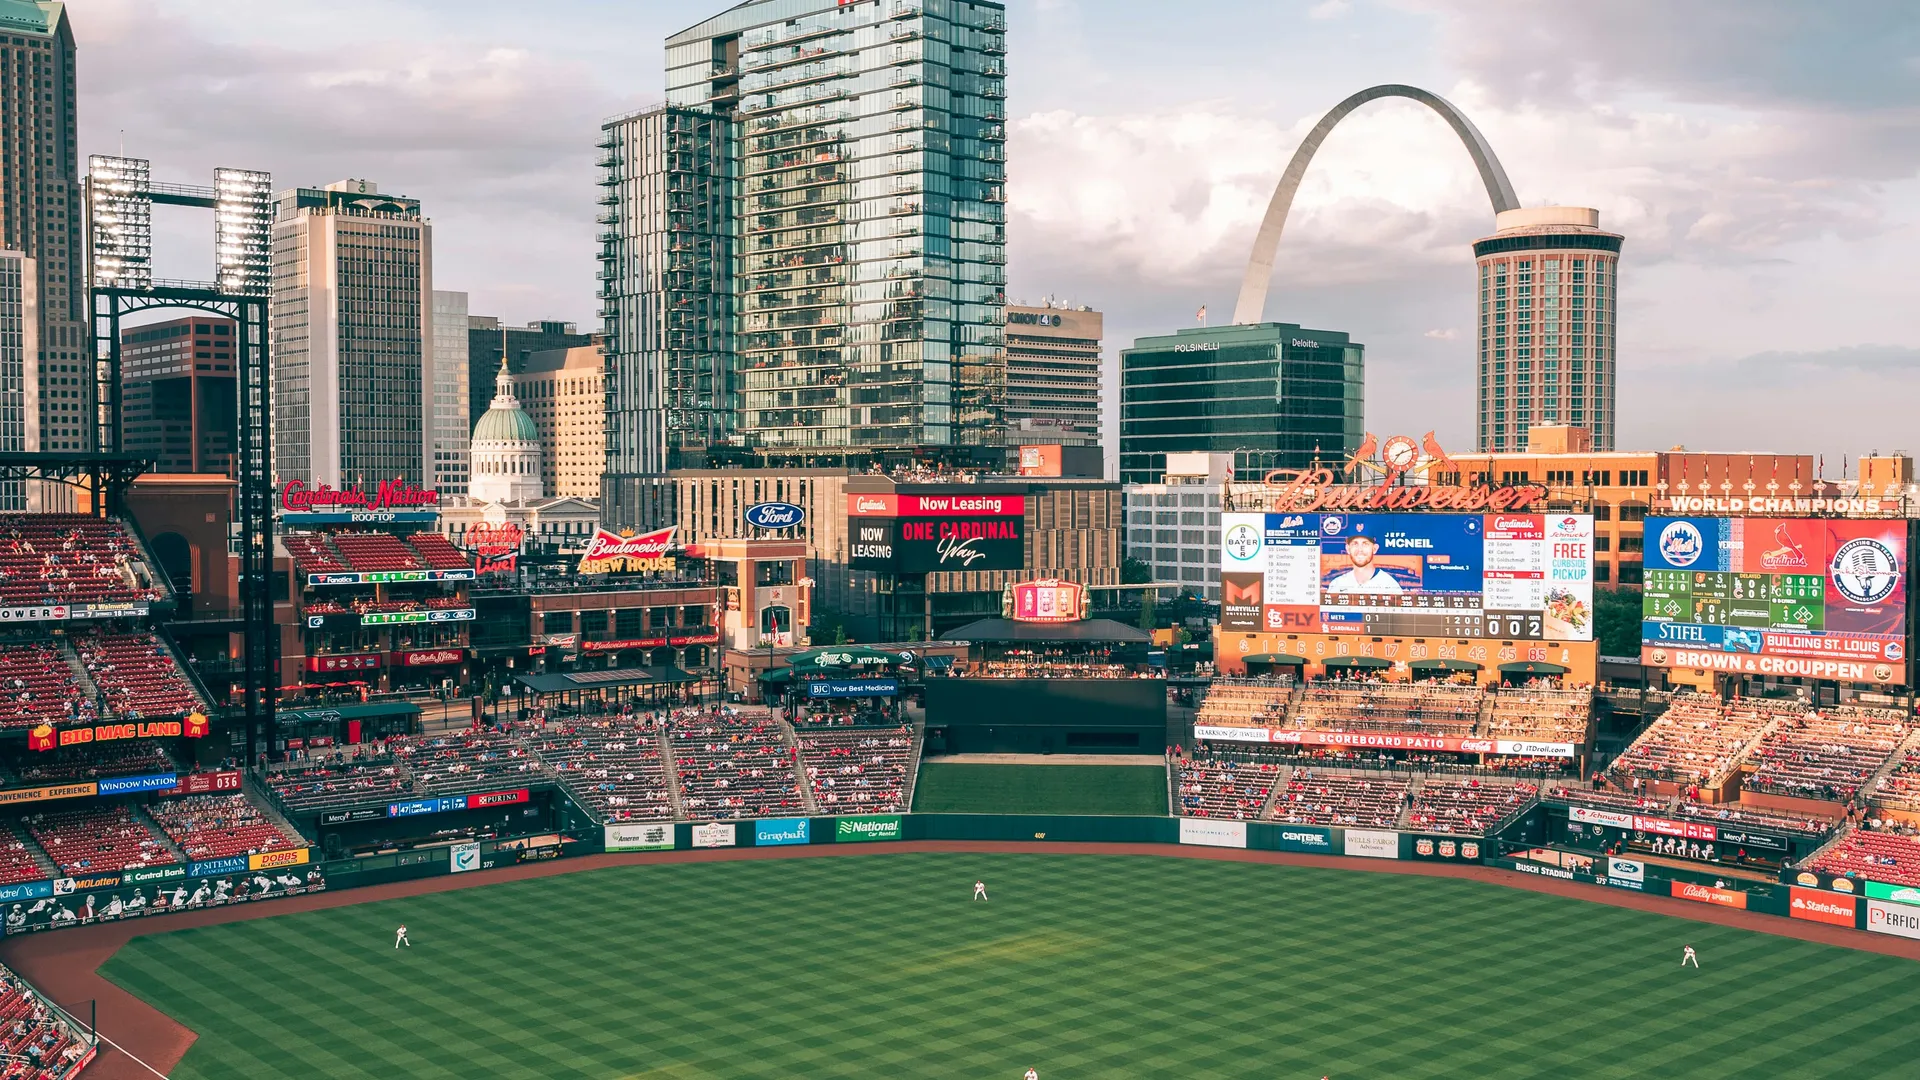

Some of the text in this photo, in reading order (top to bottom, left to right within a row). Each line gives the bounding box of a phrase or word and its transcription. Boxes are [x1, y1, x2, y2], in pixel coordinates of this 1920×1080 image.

[1007, 312, 1038, 325] KMOV
[1174, 342, 1220, 352] POLSINELLI
[282, 479, 438, 512] Cardinals Nation
[1264, 468, 1548, 512] Budweiser
[857, 496, 887, 512] Cardinals
[920, 497, 1002, 512] Now Leasing
[1669, 496, 1881, 513] WORLD CHAMPIONS
[352, 513, 395, 522] ROOFTOP
[758, 506, 793, 524] Ford
[1495, 517, 1534, 530] Cardinals
[861, 528, 883, 541] NOW
[903, 522, 1018, 540] ONE CARDINAL
[581, 537, 676, 557] Budweiser
[937, 533, 986, 566] Way
[1385, 539, 1434, 549] MCNEIL
[1554, 543, 1586, 558] FREE
[852, 545, 892, 558] LEASING
[476, 556, 516, 575] Live!
[579, 557, 677, 573] BREW HOUSE
[1552, 559, 1586, 569] CURBSIDE
[326, 575, 353, 583] Fanatics
[443, 572, 468, 580] Fanatics
[1552, 569, 1587, 580] PICKUP
[2, 607, 51, 618] OWER
[1283, 612, 1315, 627] FLY
[1488, 621, 1541, 637] 0 0 2
[1659, 622, 1706, 641] STIFEL
[1767, 635, 1880, 653] BUILDING ST. LOUIS
[1336, 642, 1547, 662] 10 14 17 20 24 42 45 85
[873, 656, 889, 664] Deck
[1675, 651, 1864, 679] BROWN & CROUPPEN
[813, 685, 828, 694] BJC
[865, 683, 895, 692] Medicine
[60, 721, 182, 746] BIG MAC LAND
[1272, 731, 1301, 742] Coca-Cola
[1318, 734, 1402, 746] SCOREBOARD
[1406, 738, 1445, 748] PATIO
[1461, 740, 1493, 752] Coca-Cola
[49, 786, 92, 797] EXPERIENCE
[100, 780, 140, 792] WINDOW
[142, 775, 177, 788] NATION
[216, 777, 238, 789] 036
[487, 794, 518, 805] PURINA
[400, 806, 410, 815] 47
[1588, 811, 1629, 823] Schnucks
[328, 813, 346, 822] Mercy
[852, 820, 898, 833] National
[1645, 821, 1655, 830] 50
[618, 835, 640, 844] Ameren
[716, 829, 729, 837] FAME
[1282, 831, 1325, 843] CENTENE
[1723, 832, 1741, 842] Mercy
[451, 842, 480, 853] CarShield
[1301, 839, 1329, 847] Corporation
[1347, 836, 1396, 847] WELLS FARGO
[1359, 843, 1384, 851] Advisors
[203, 856, 246, 870] SITEMAN
[261, 851, 299, 864] DOBBS
[203, 865, 246, 876] CANCER CENTER
[1515, 862, 1574, 879] BUSCH STADIUM
[1617, 861, 1635, 873] Ford
[75, 866, 186, 890] MOLottery Central Bank
[1683, 884, 1733, 904] Bally SPORTS
